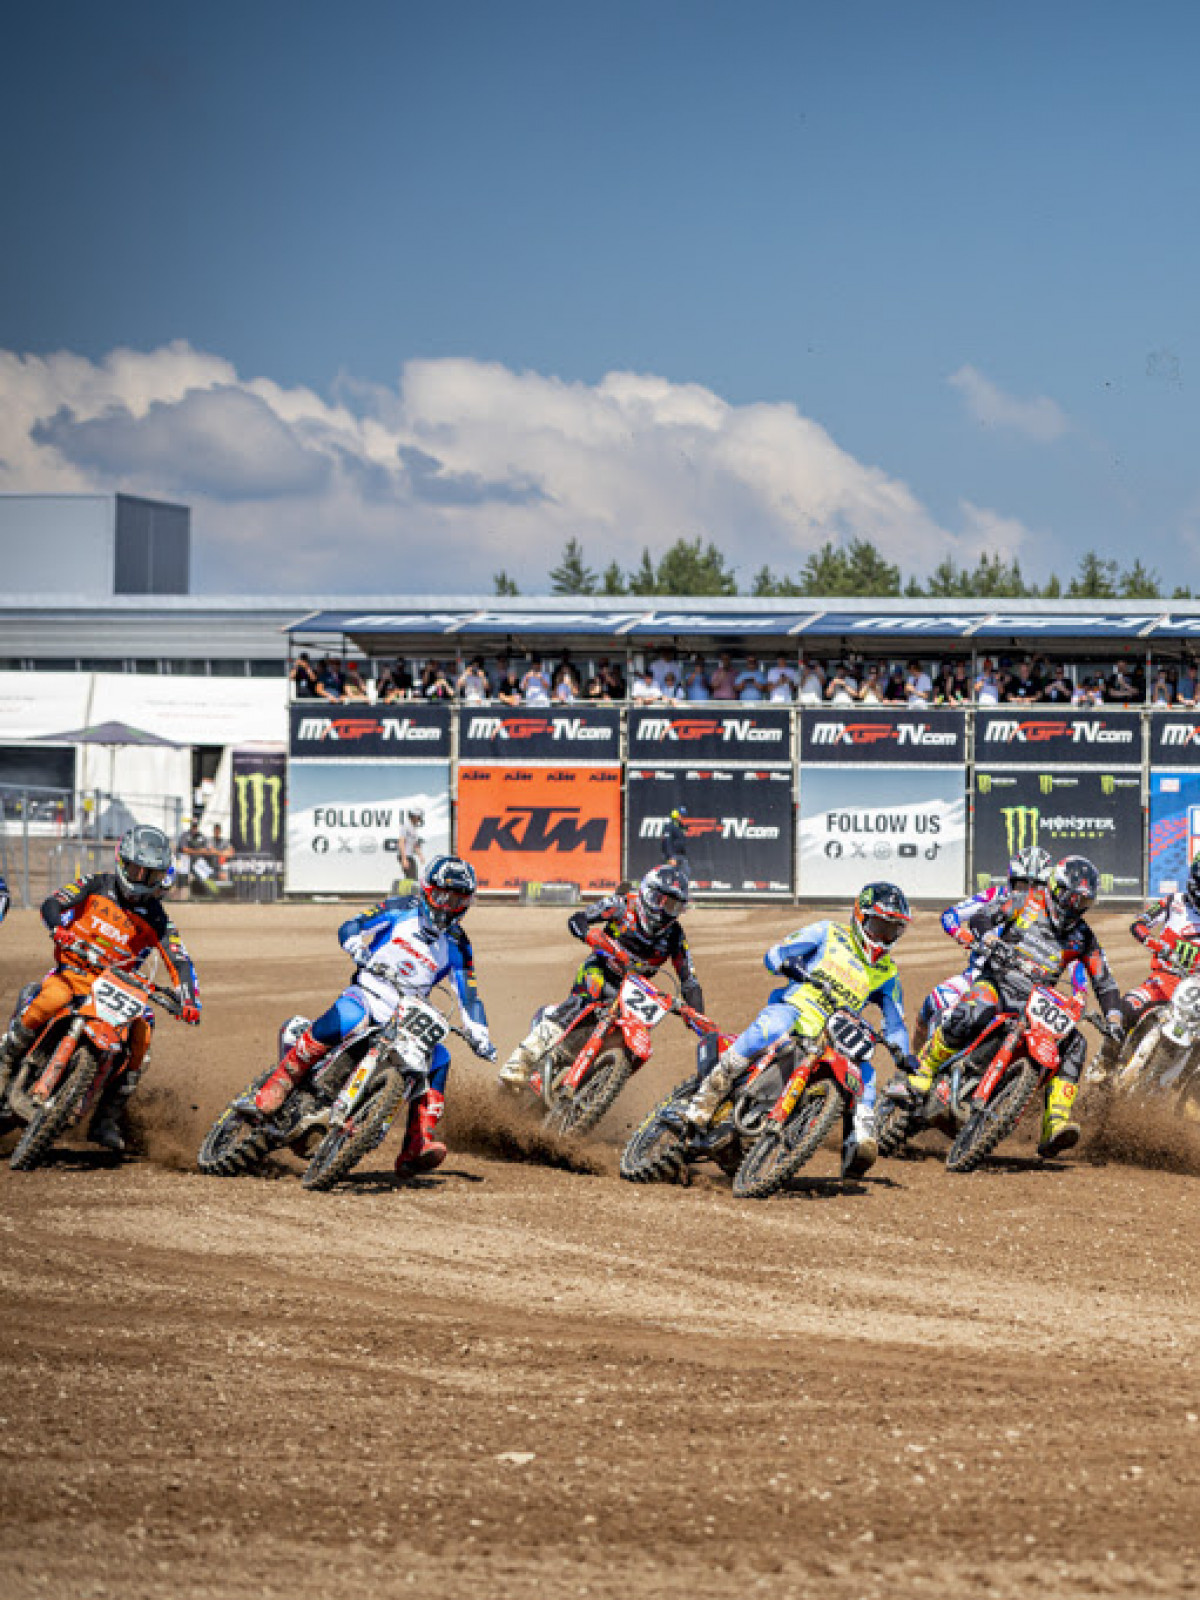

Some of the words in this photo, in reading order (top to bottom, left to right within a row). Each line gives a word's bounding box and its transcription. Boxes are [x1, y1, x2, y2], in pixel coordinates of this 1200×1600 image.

[313, 808, 392, 828] FOLLOW
[470, 805, 608, 853] KTM
[826, 814, 908, 834] FOLLOW
[915, 814, 941, 834] US
[1039, 815, 1116, 831] MONSTER
[95, 981, 142, 1018] 253
[624, 988, 659, 1021] 24
[1030, 998, 1069, 1033] 303
